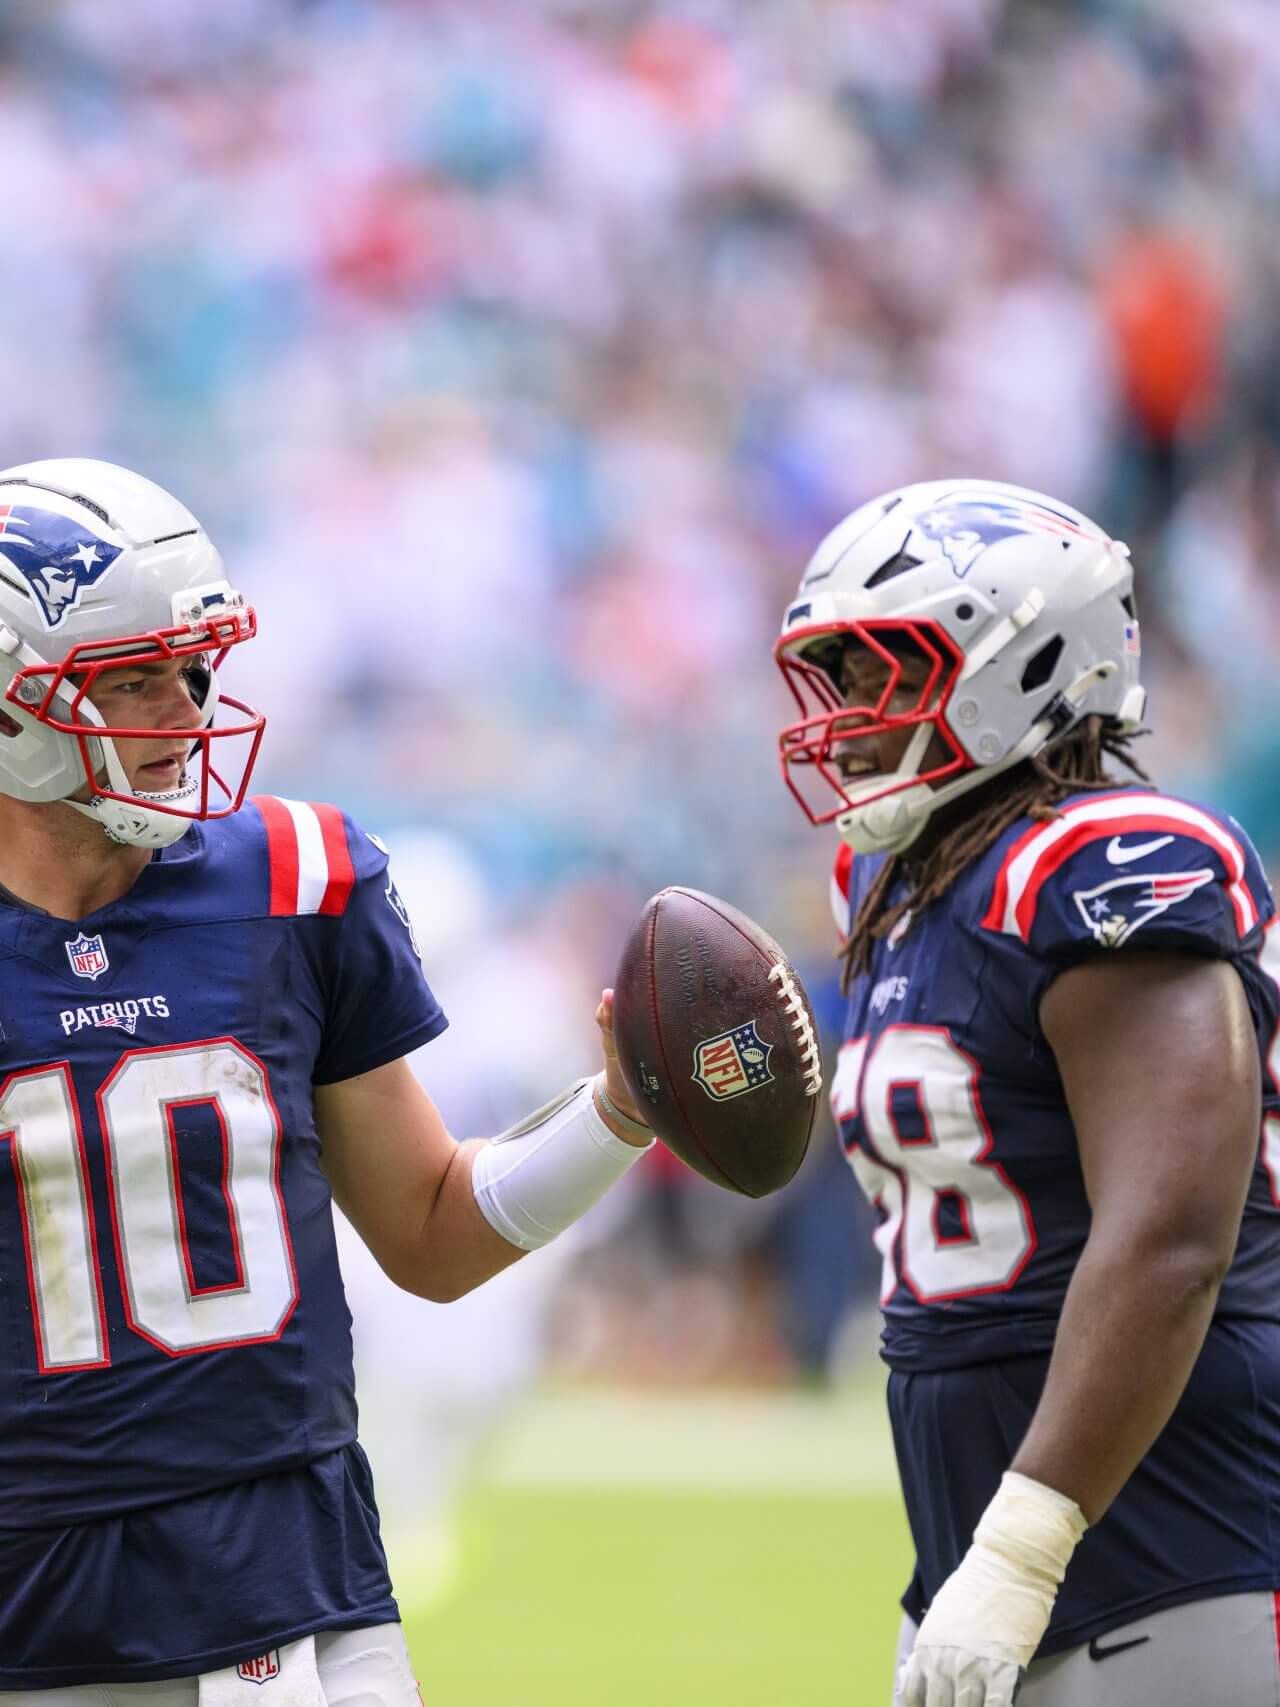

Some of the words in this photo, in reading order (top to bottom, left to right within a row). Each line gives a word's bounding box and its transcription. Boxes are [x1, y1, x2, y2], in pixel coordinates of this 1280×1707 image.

[75, 952, 103, 972] NFL
[60, 995, 170, 1036] PATRIOTS
[703, 1039, 745, 1095] NFL
[241, 1652, 276, 1677] NFL
